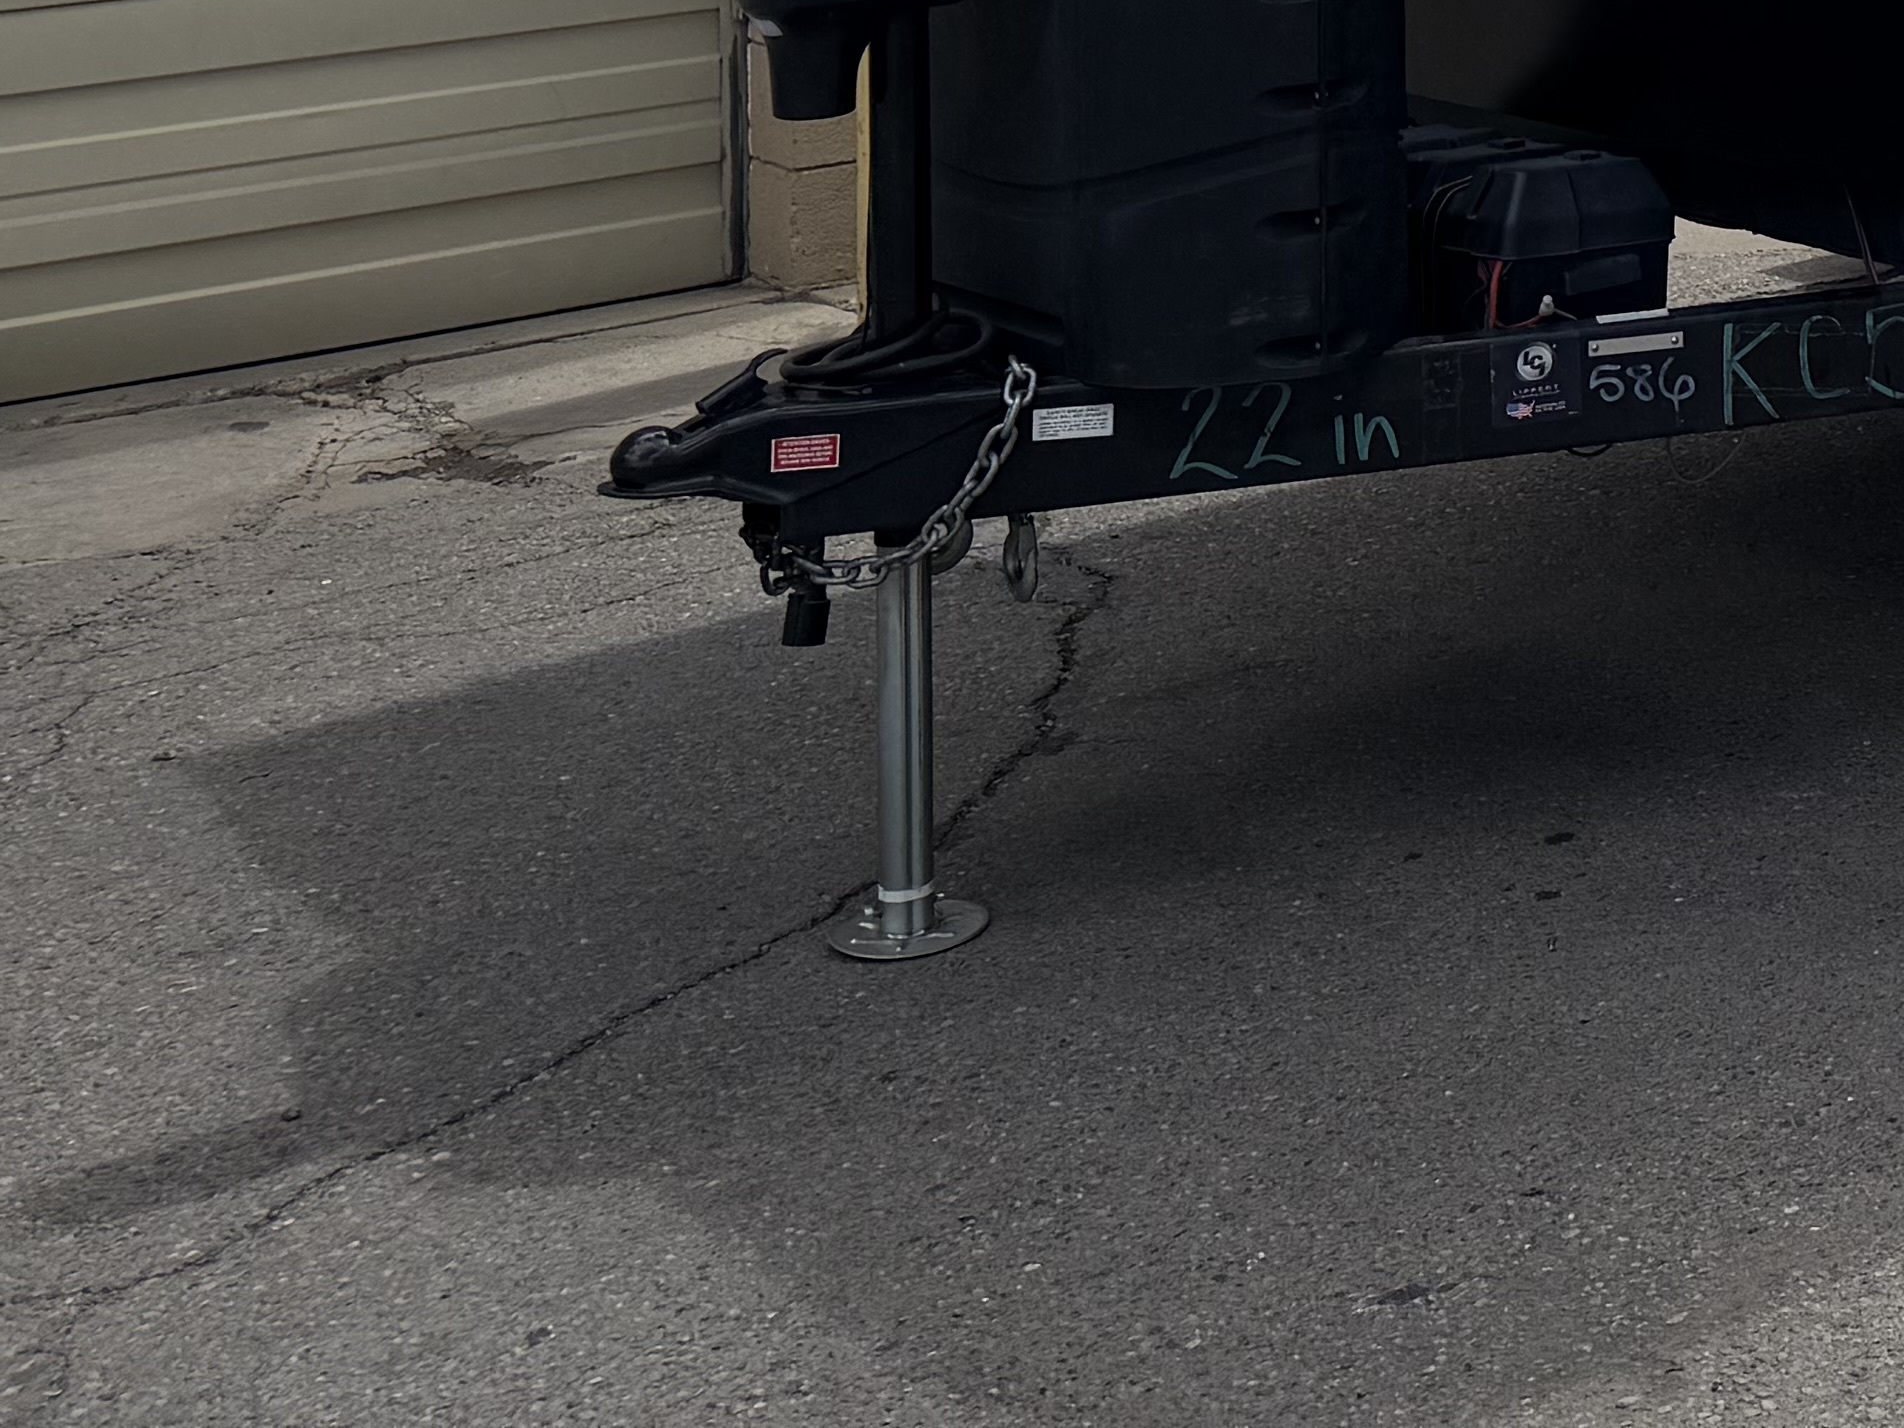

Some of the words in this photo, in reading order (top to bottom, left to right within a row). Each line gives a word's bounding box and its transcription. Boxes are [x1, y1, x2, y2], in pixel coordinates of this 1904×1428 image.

[1588, 355, 1697, 412] 586
[1168, 381, 1303, 481] 22
[1331, 392, 1401, 466] in
